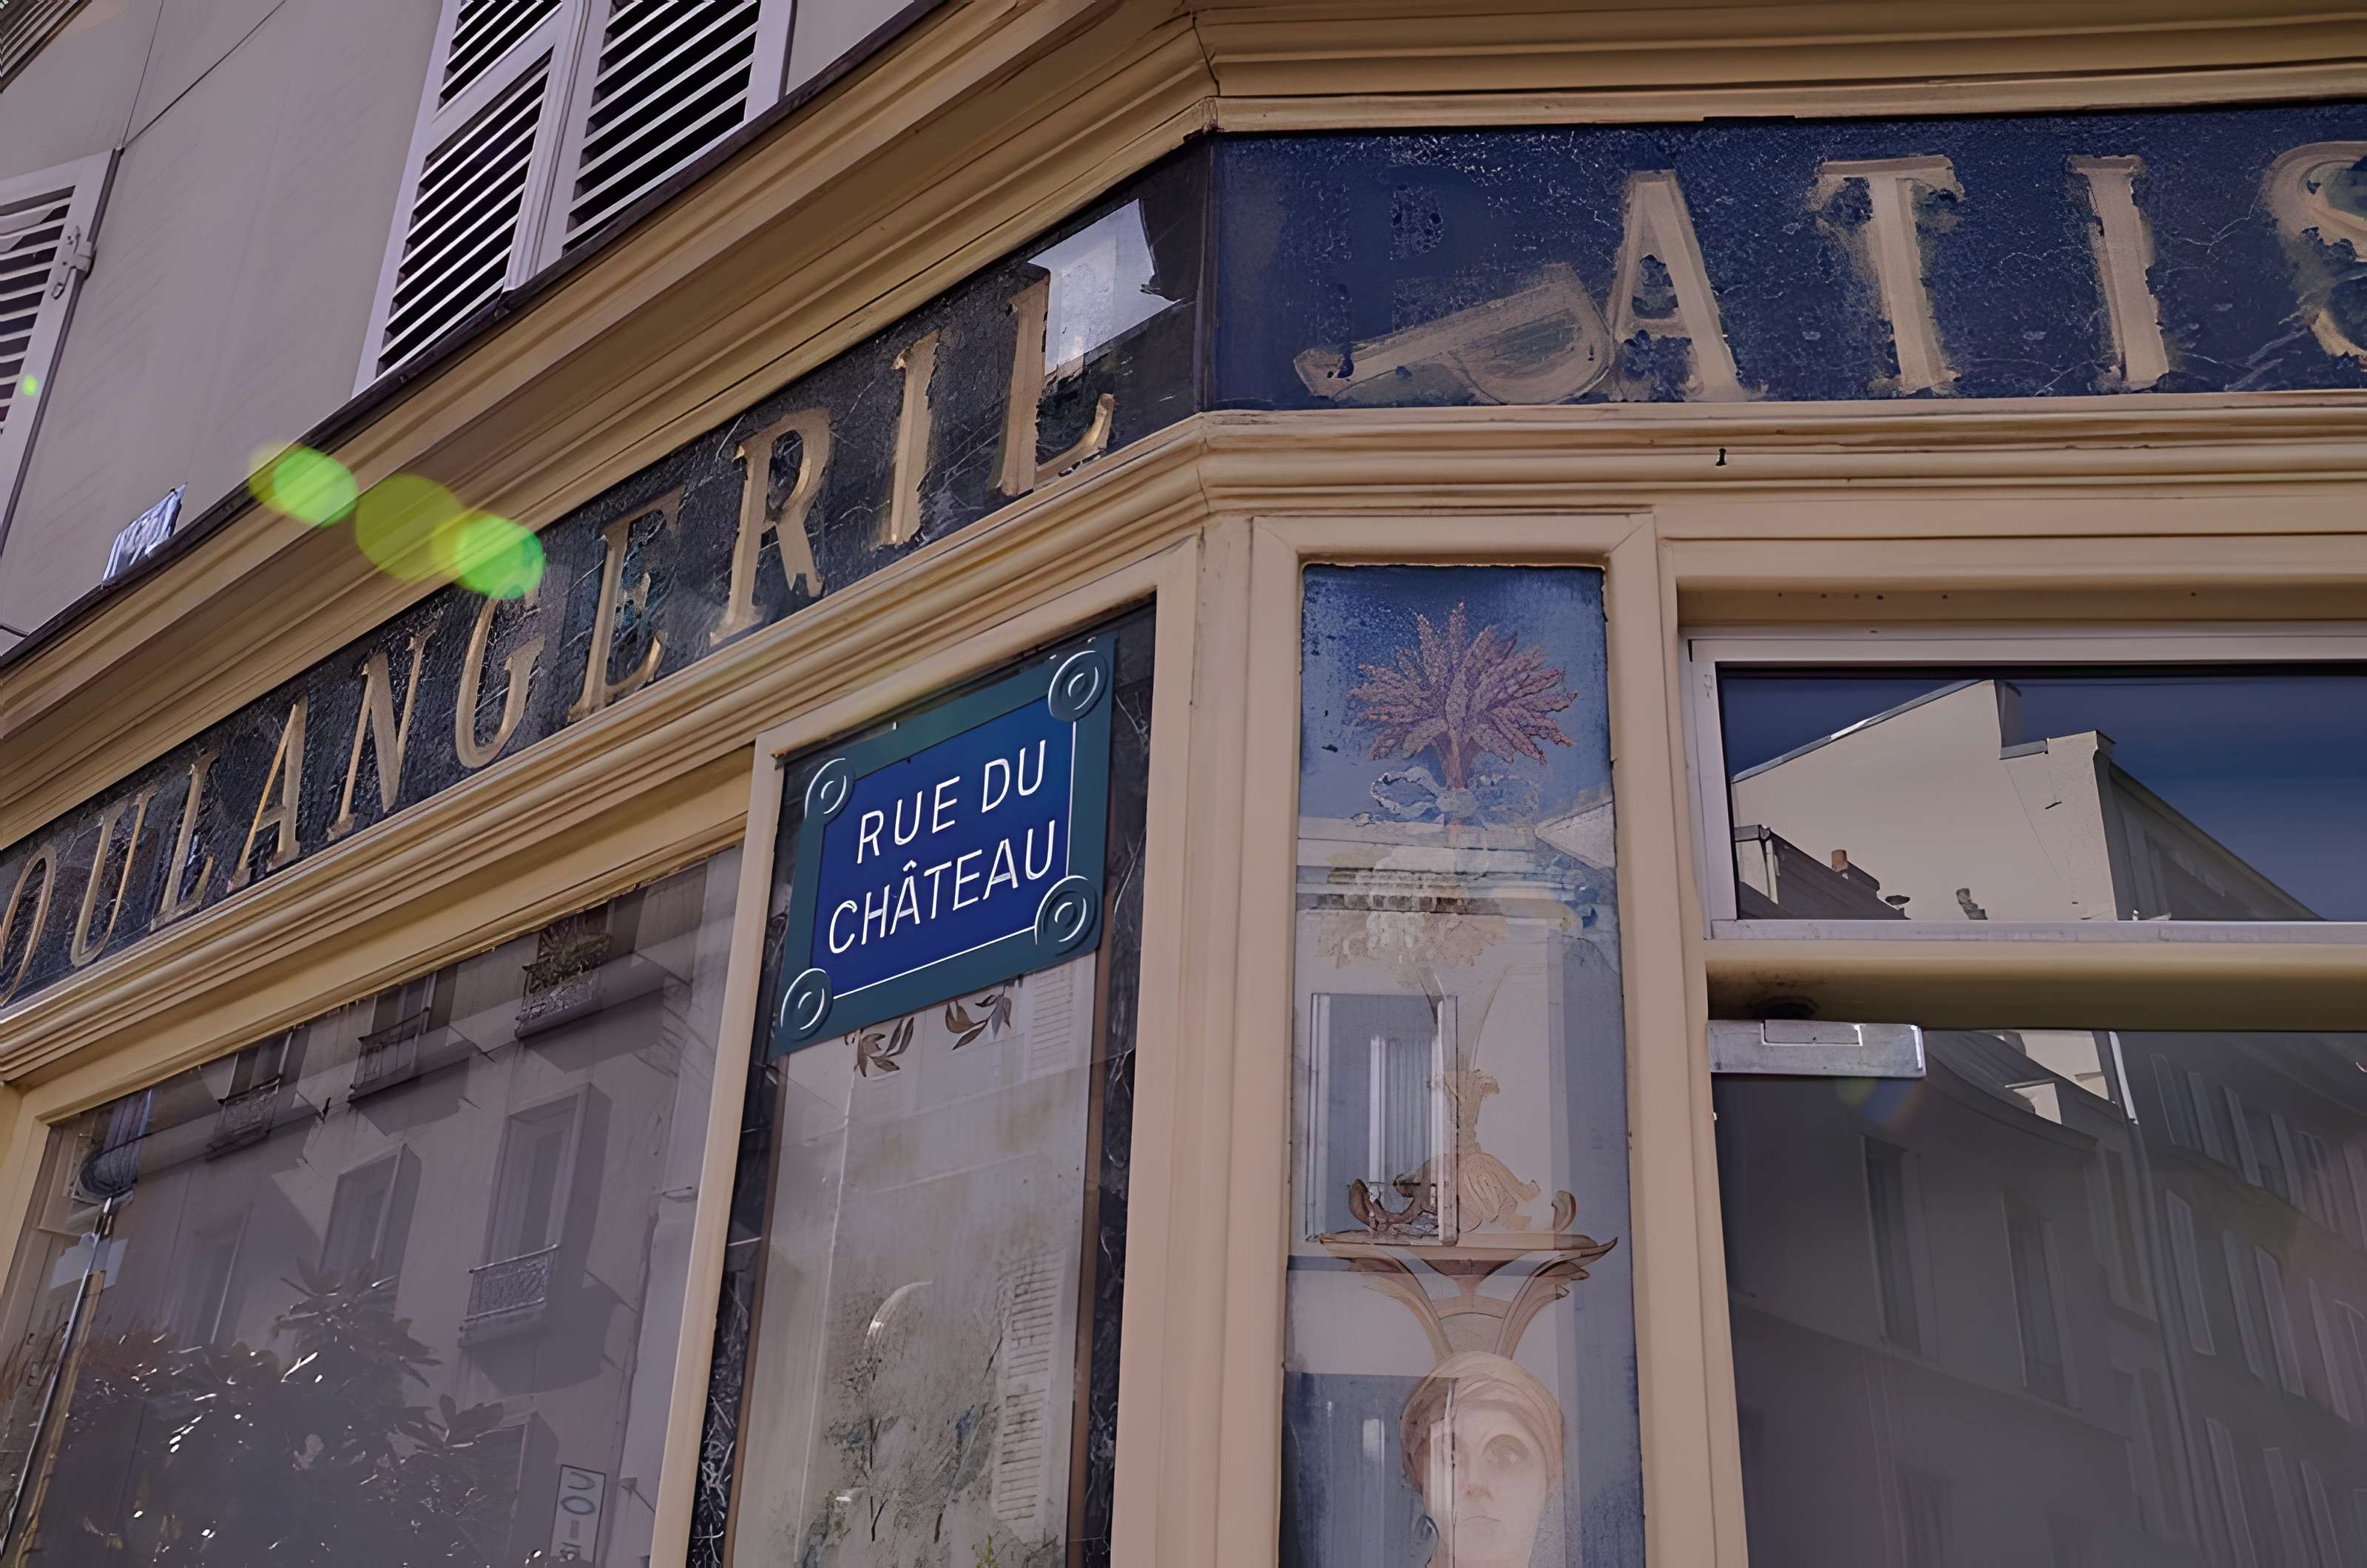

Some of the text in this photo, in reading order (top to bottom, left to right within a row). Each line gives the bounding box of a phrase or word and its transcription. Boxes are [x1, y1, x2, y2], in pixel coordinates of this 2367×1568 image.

[857, 740, 1047, 864] RUE DU
[828, 820, 1056, 954] CHÂTEAU
